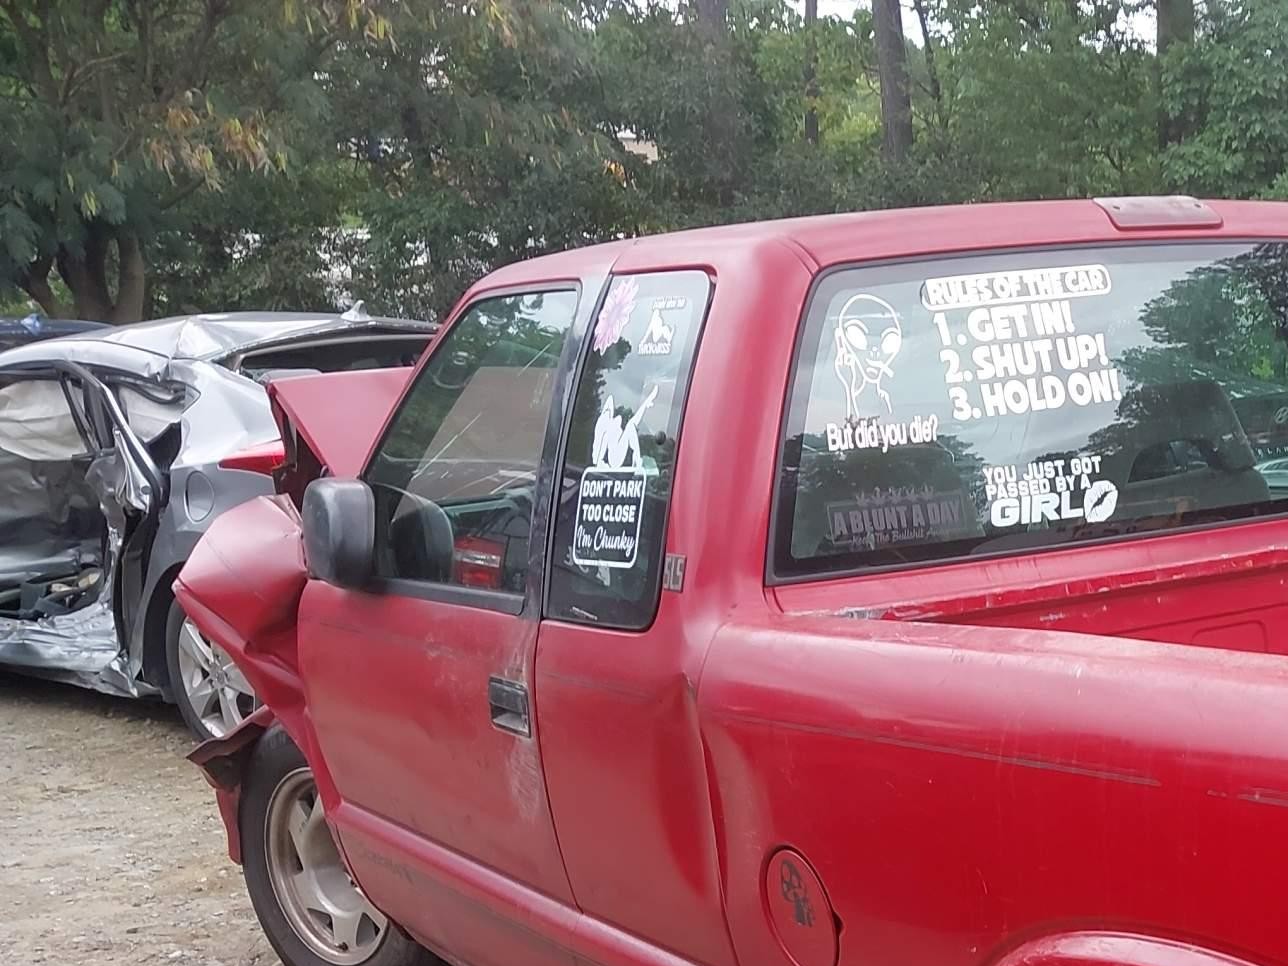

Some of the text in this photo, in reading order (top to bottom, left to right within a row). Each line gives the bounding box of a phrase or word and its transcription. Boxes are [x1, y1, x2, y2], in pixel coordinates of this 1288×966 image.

[927, 268, 1105, 305] RULES OF THE CAR
[933, 300, 1076, 346] 1. GET IN!
[939, 333, 1109, 384] 2. SHUT UP!
[948, 368, 1122, 421] 3. HOLD ON!
[826, 414, 938, 454] But did you die?
[582, 480, 642, 498] DON'T PARK
[982, 456, 1102, 485] YOU JUST GOT
[985, 473, 1092, 502] PASSED BY A
[582, 504, 637, 523] TOO CLOSE
[833, 496, 960, 536] A BLUNT A DAY
[990, 490, 1084, 528] GIRL
[576, 525, 634, 558] I'm Chunky
